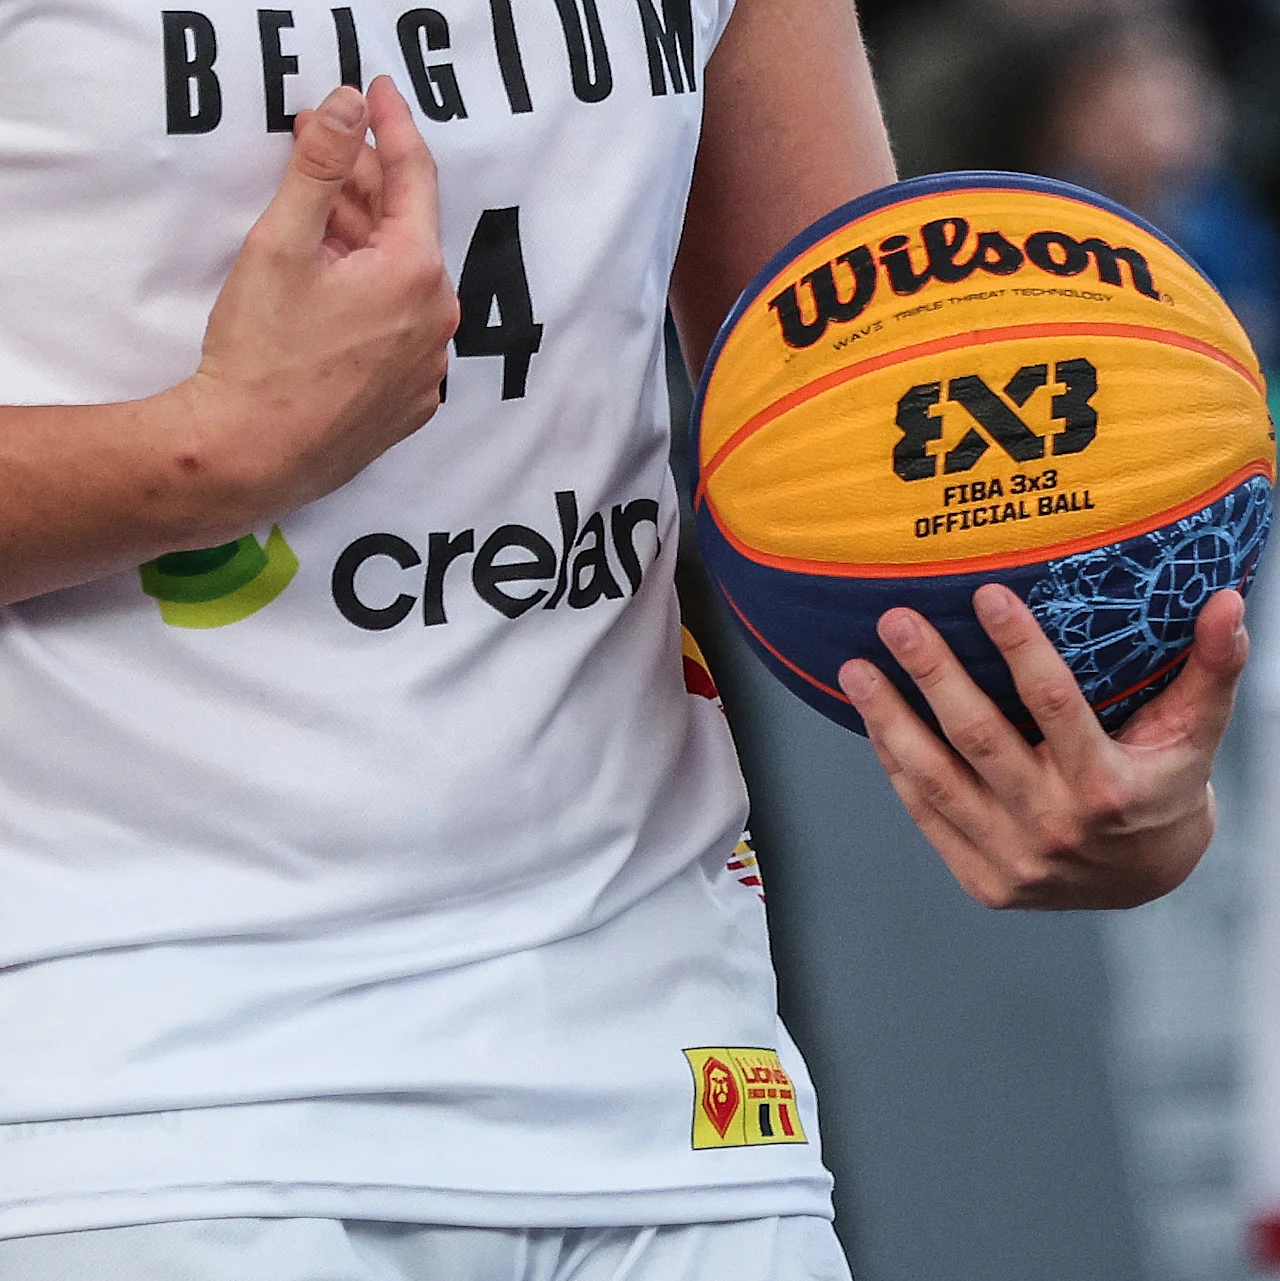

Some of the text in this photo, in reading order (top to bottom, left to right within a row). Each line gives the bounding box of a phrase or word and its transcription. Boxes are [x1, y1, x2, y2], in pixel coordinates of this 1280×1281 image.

[440, 206, 544, 404] 4
[767, 216, 1160, 349] Wilson
[832, 287, 1114, 351] WAVE TRIPLE THREAT TECHNOLOGY
[914, 490, 1095, 538] OFFICIAL BALL
[943, 469, 1058, 507] FIBA 3x3
